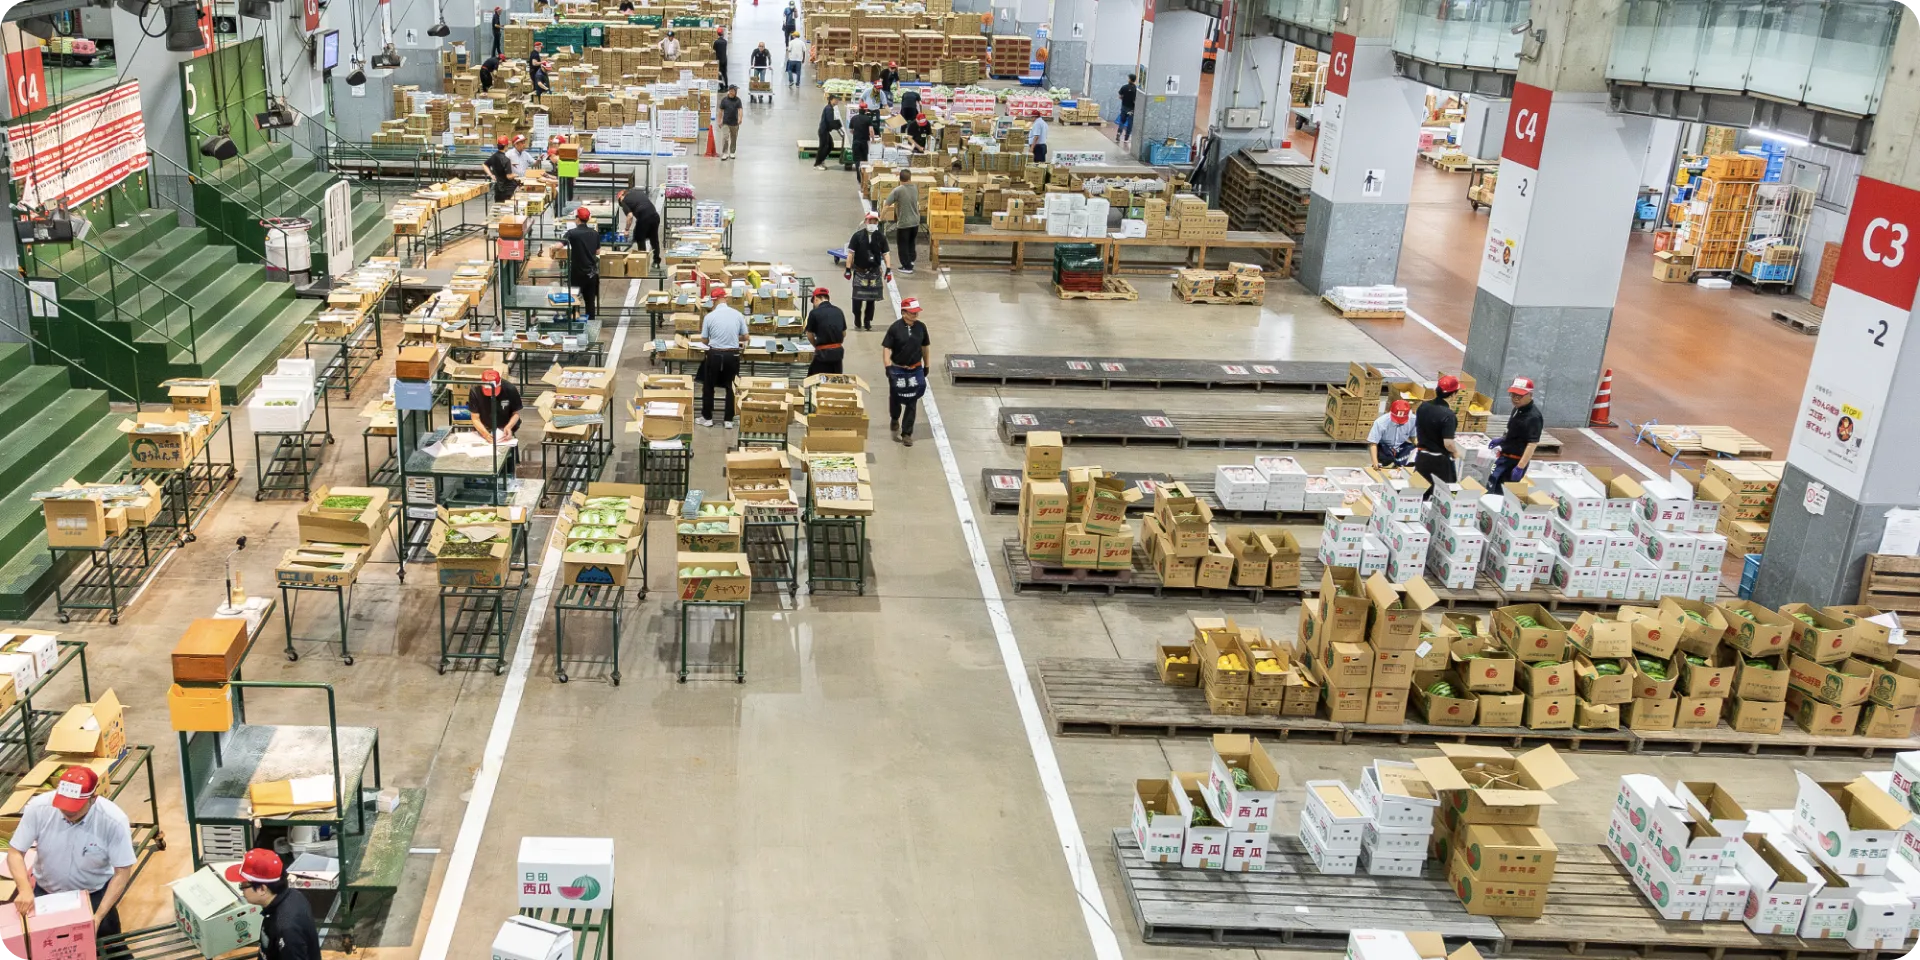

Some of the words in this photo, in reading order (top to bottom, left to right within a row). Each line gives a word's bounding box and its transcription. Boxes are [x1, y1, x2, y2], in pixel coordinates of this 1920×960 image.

[1334, 52, 1348, 78] C5
[18, 72, 39, 108] C4
[185, 64, 198, 116] 5
[1335, 104, 1342, 118] -2
[1515, 108, 1538, 142] C4
[1518, 178, 1528, 198] -2
[1862, 217, 1908, 268] C3
[1868, 319, 1888, 348] -2
[1662, 511, 1685, 520] 西瓜
[714, 585, 746, 596] キャベツ
[1893, 771, 1911, 795] 西瓜
[1238, 806, 1268, 817] 西瓜
[1618, 792, 1630, 814] 西瓜
[1800, 808, 1816, 827] 西瓜
[1609, 826, 1621, 847] 西瓜
[1648, 829, 1663, 851] 西瓜
[1191, 843, 1221, 855] 西瓜
[1233, 847, 1262, 858] 西瓜
[1849, 848, 1888, 859] 熊本西瓜
[526, 872, 548, 881] 日田
[1636, 862, 1650, 885] 西瓜
[523, 883, 552, 894] 西瓜
